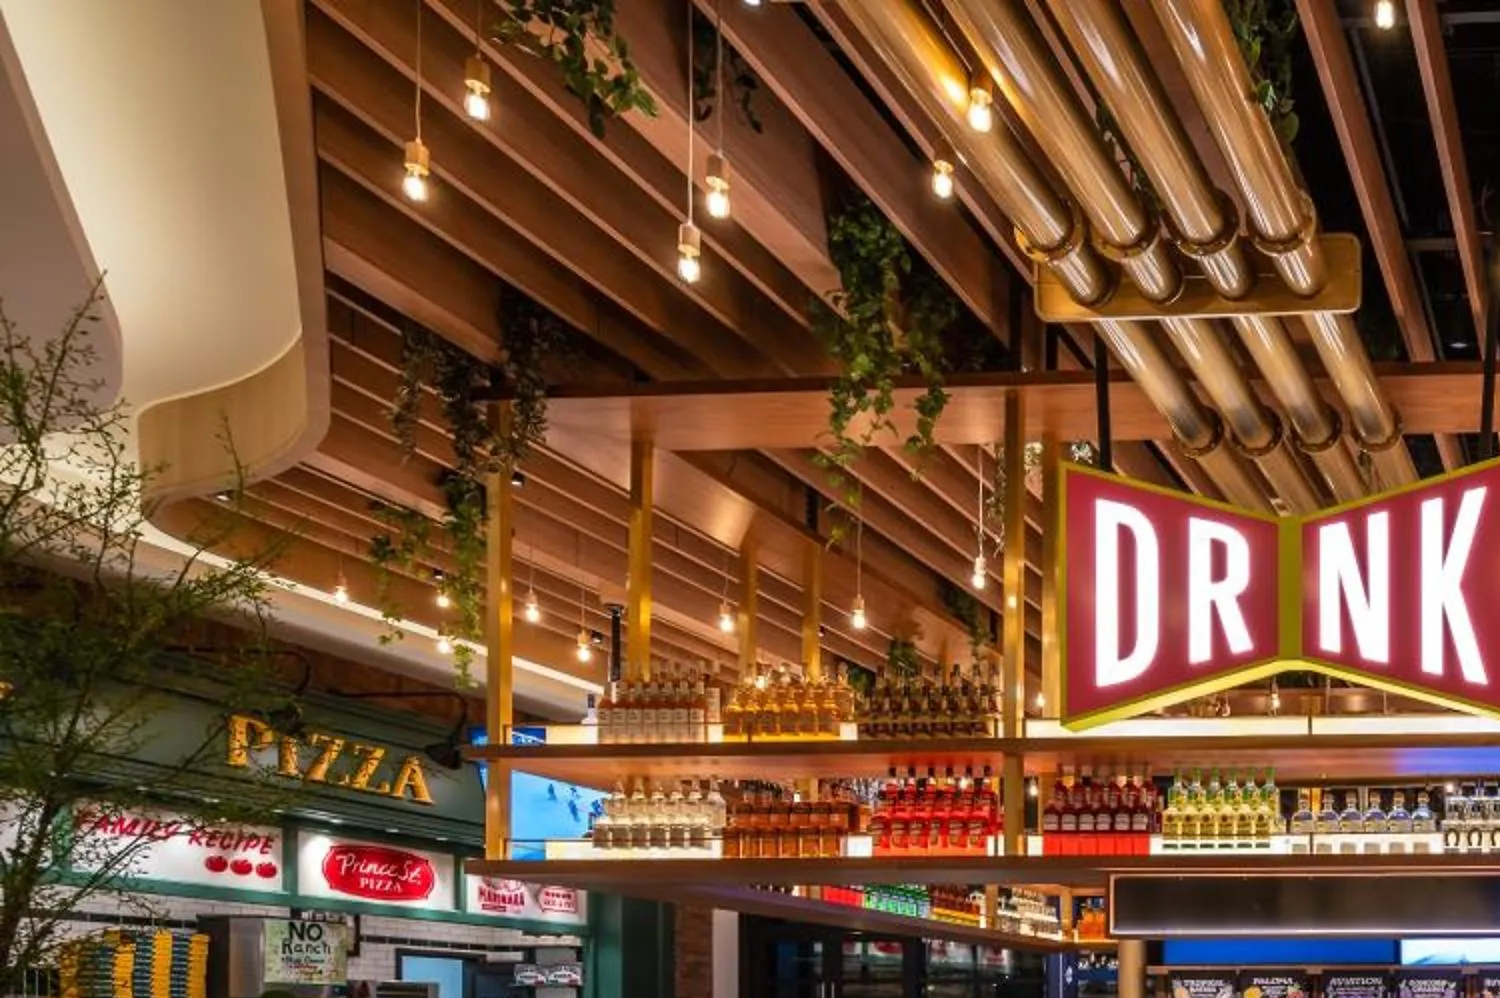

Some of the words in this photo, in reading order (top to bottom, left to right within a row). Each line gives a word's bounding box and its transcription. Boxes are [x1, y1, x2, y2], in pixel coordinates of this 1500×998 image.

[225, 714, 435, 806] PIZZA
[189, 825, 275, 855] RECIPE
[335, 852, 397, 877] Prince
[359, 876, 403, 893] PIZZA
[288, 921, 323, 941] NO
